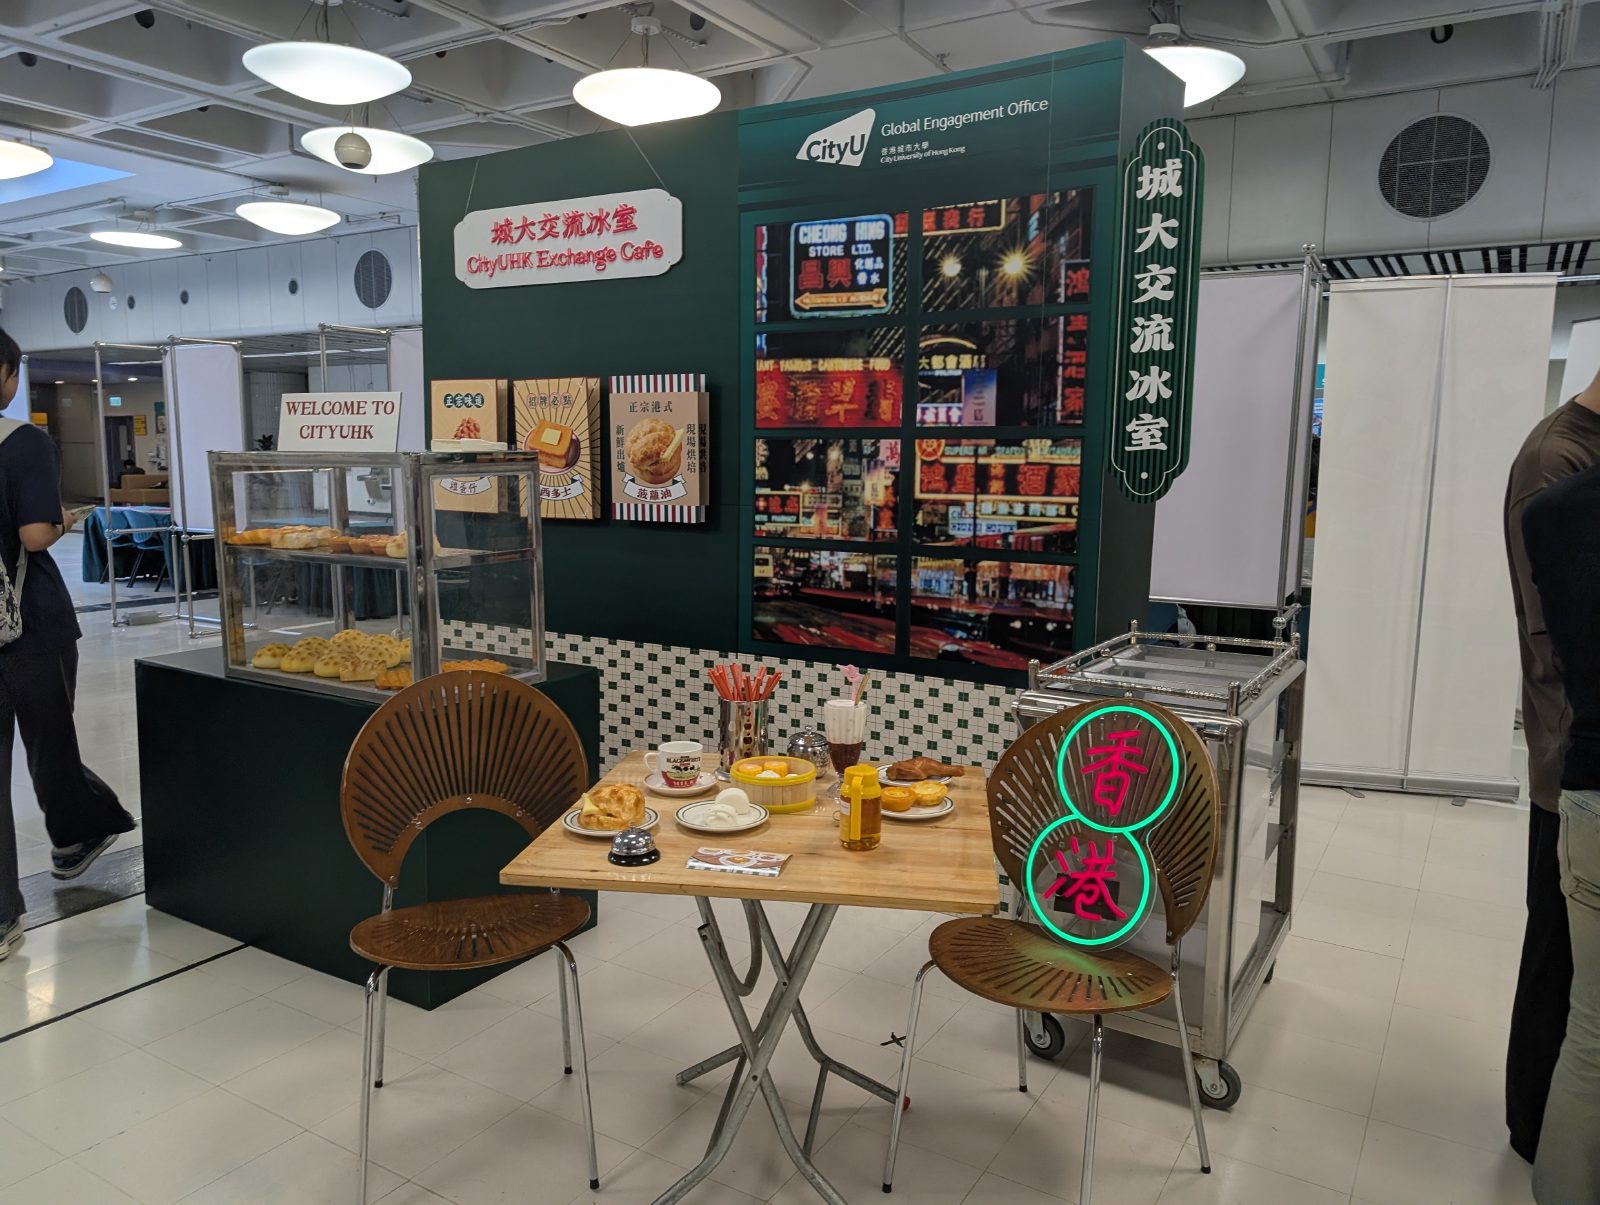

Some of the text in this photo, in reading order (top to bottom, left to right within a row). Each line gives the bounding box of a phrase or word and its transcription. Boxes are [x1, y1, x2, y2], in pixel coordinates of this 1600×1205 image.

[881, 99, 1049, 137] Global Engagement Office
[806, 133, 866, 164] CityU
[893, 151, 923, 161] University
[923, 149, 932, 157] of
[932, 148, 949, 156] Hong
[948, 146, 966, 154] Kong
[491, 203, 638, 245] 城大交流冰室
[799, 223, 848, 245] CHEONG
[854, 220, 886, 242] HING
[466, 240, 665, 278] CityUHK Exchange Cafe
[808, 245, 845, 257] STORE
[1124, 158, 1183, 452] 城大交流冰室
[285, 401, 395, 415] WELCOME TO
[444, 393, 485, 408] 正宗味道
[528, 393, 573, 409] 招牌必點
[629, 401, 673, 413] 正宗港式
[299, 424, 374, 439] CITYUHK
[615, 424, 626, 473] 新鮮出爐
[540, 487, 572, 498] 西多士
[637, 488, 672, 500] 菠蘿油
[1043, 730, 1148, 922] 香港
